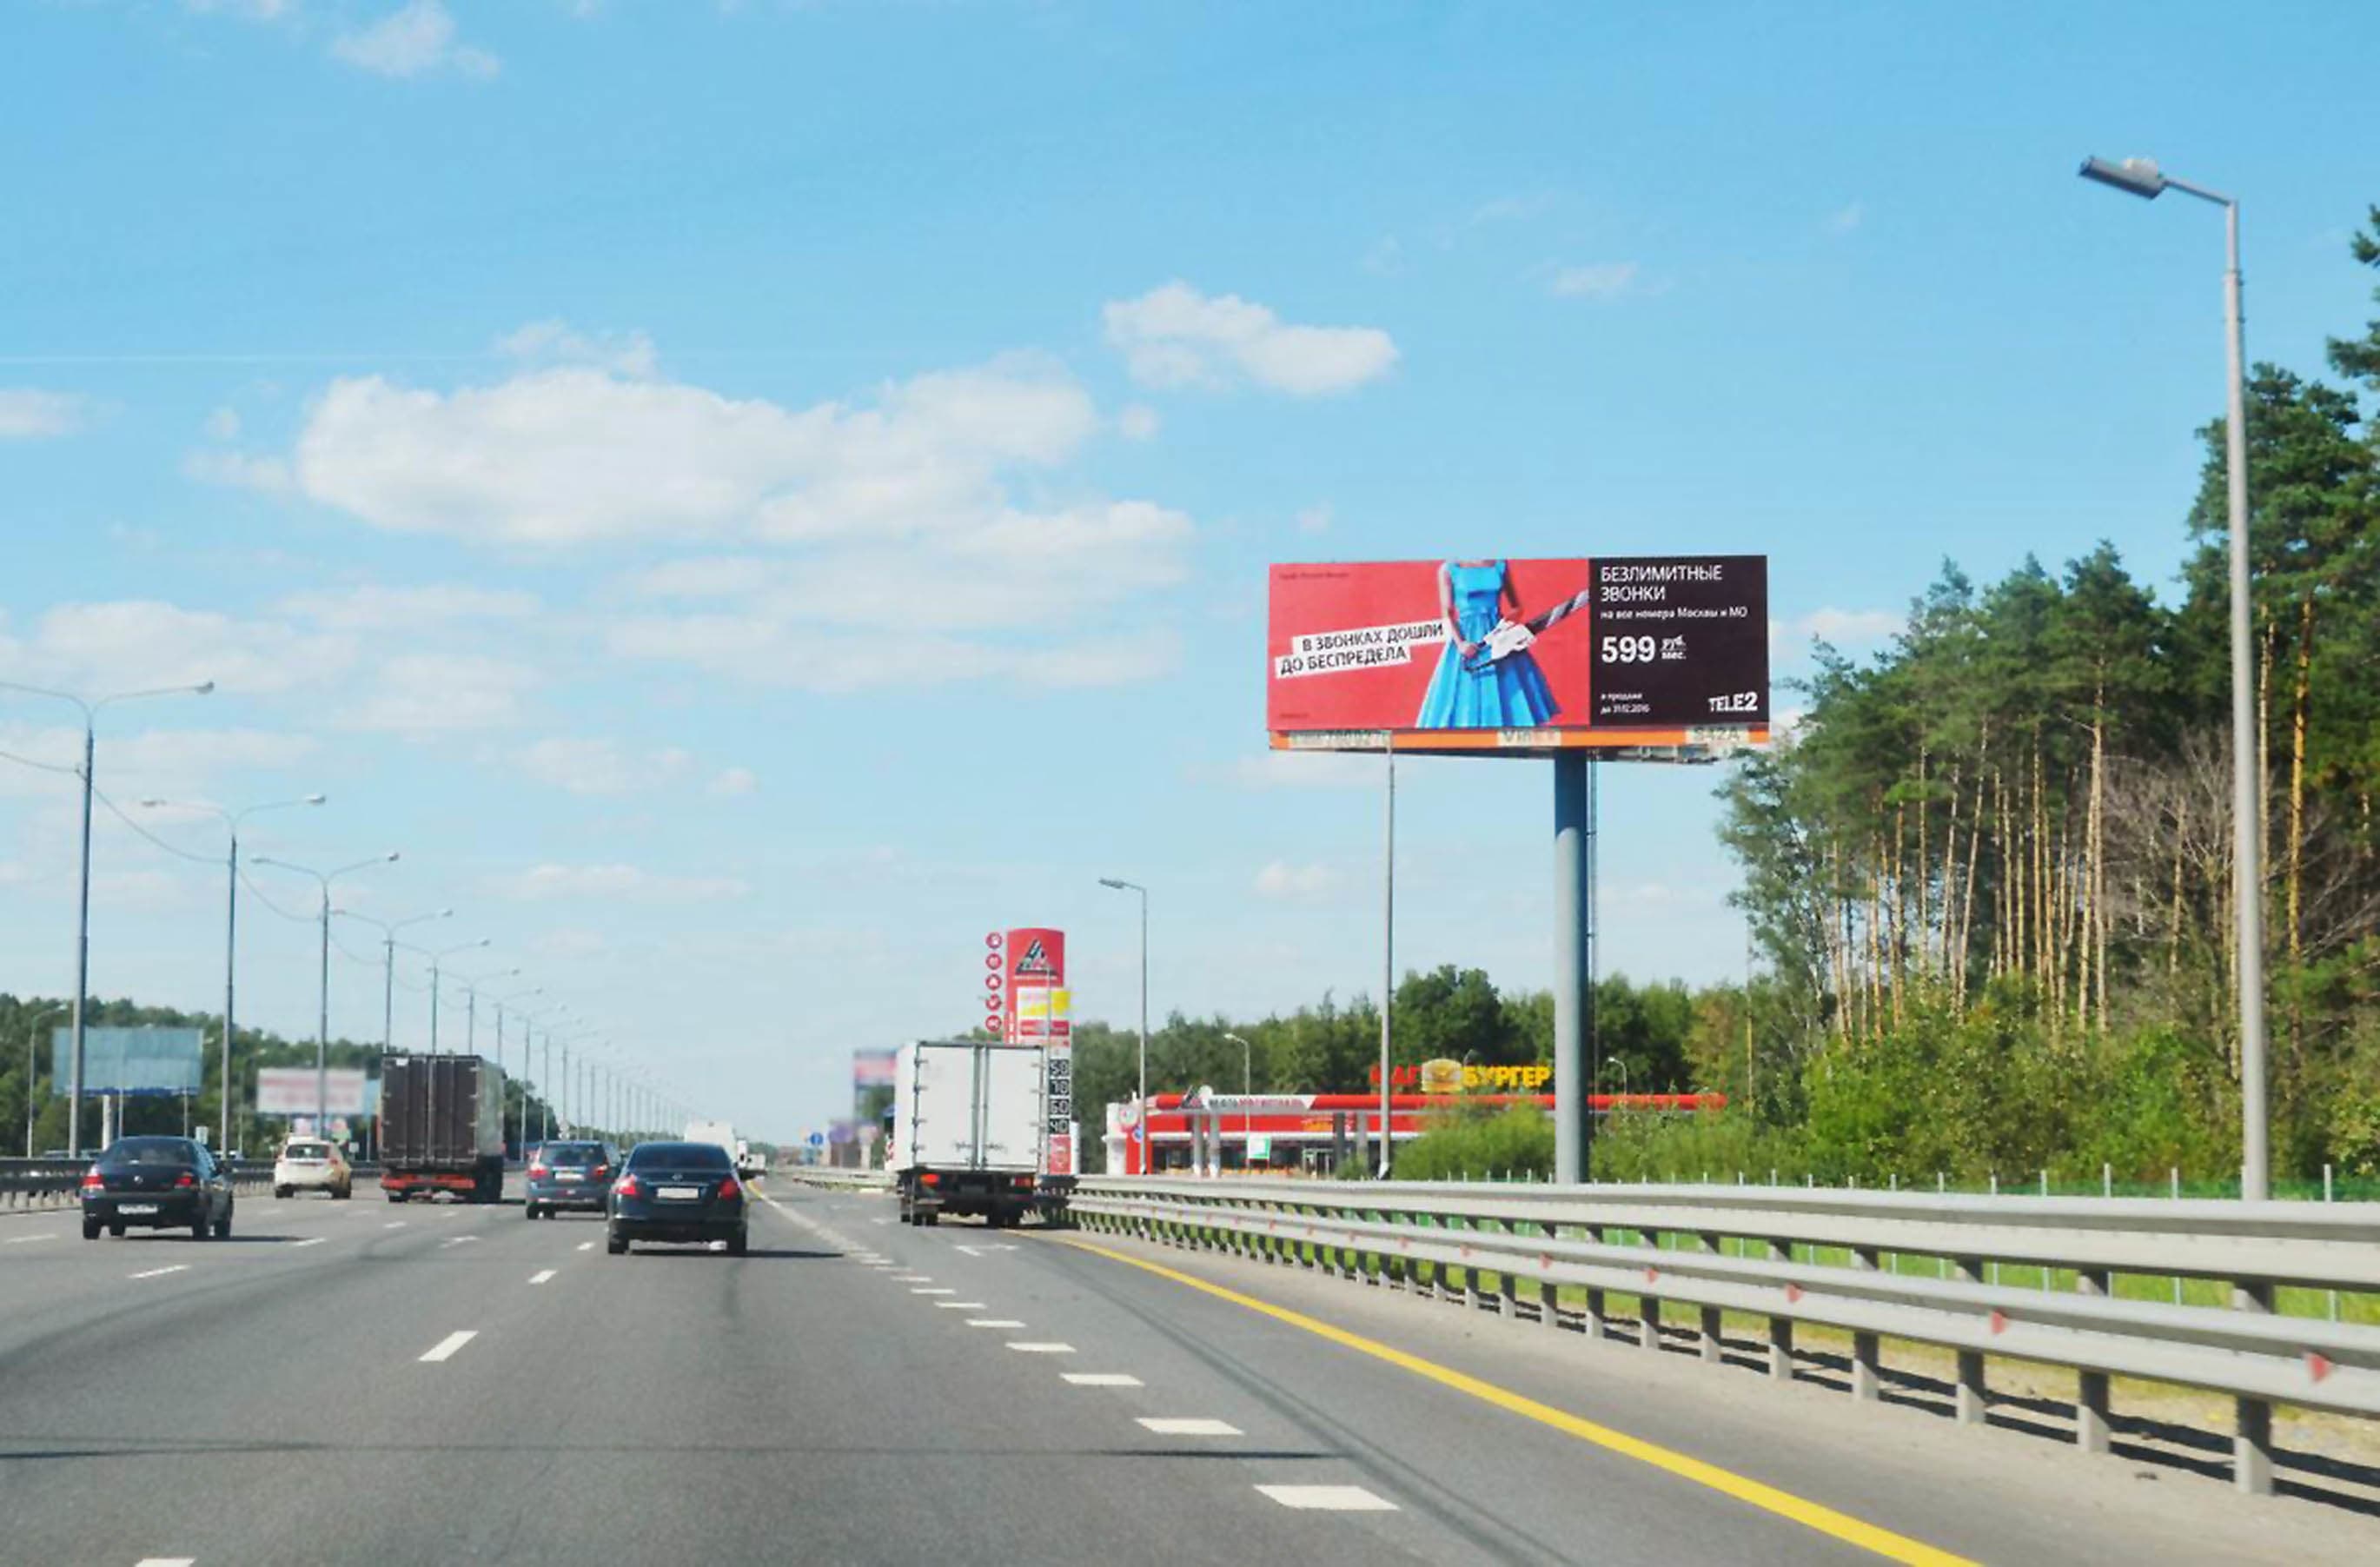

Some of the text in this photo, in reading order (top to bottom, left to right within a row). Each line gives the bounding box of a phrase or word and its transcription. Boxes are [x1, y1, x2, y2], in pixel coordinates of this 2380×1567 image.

[1601, 565, 1723, 582] БЕЗЛИМИТНЫЕ
[1601, 586, 1666, 601] ЗВОНКИ
[1601, 610, 1614, 619] на
[1616, 610, 1633, 619] все
[1635, 609, 1675, 620] номера
[1729, 607, 1748, 617] МО
[1303, 623, 1444, 652] В ЗВОНКАХ ДОШЛИ
[1601, 635, 1655, 663] 599
[1281, 646, 1407, 675] ДО БЕСПРЕДЕЛА
[1708, 691, 1758, 713] TELE2
[1462, 1065, 1551, 1087] БУРГЕР
